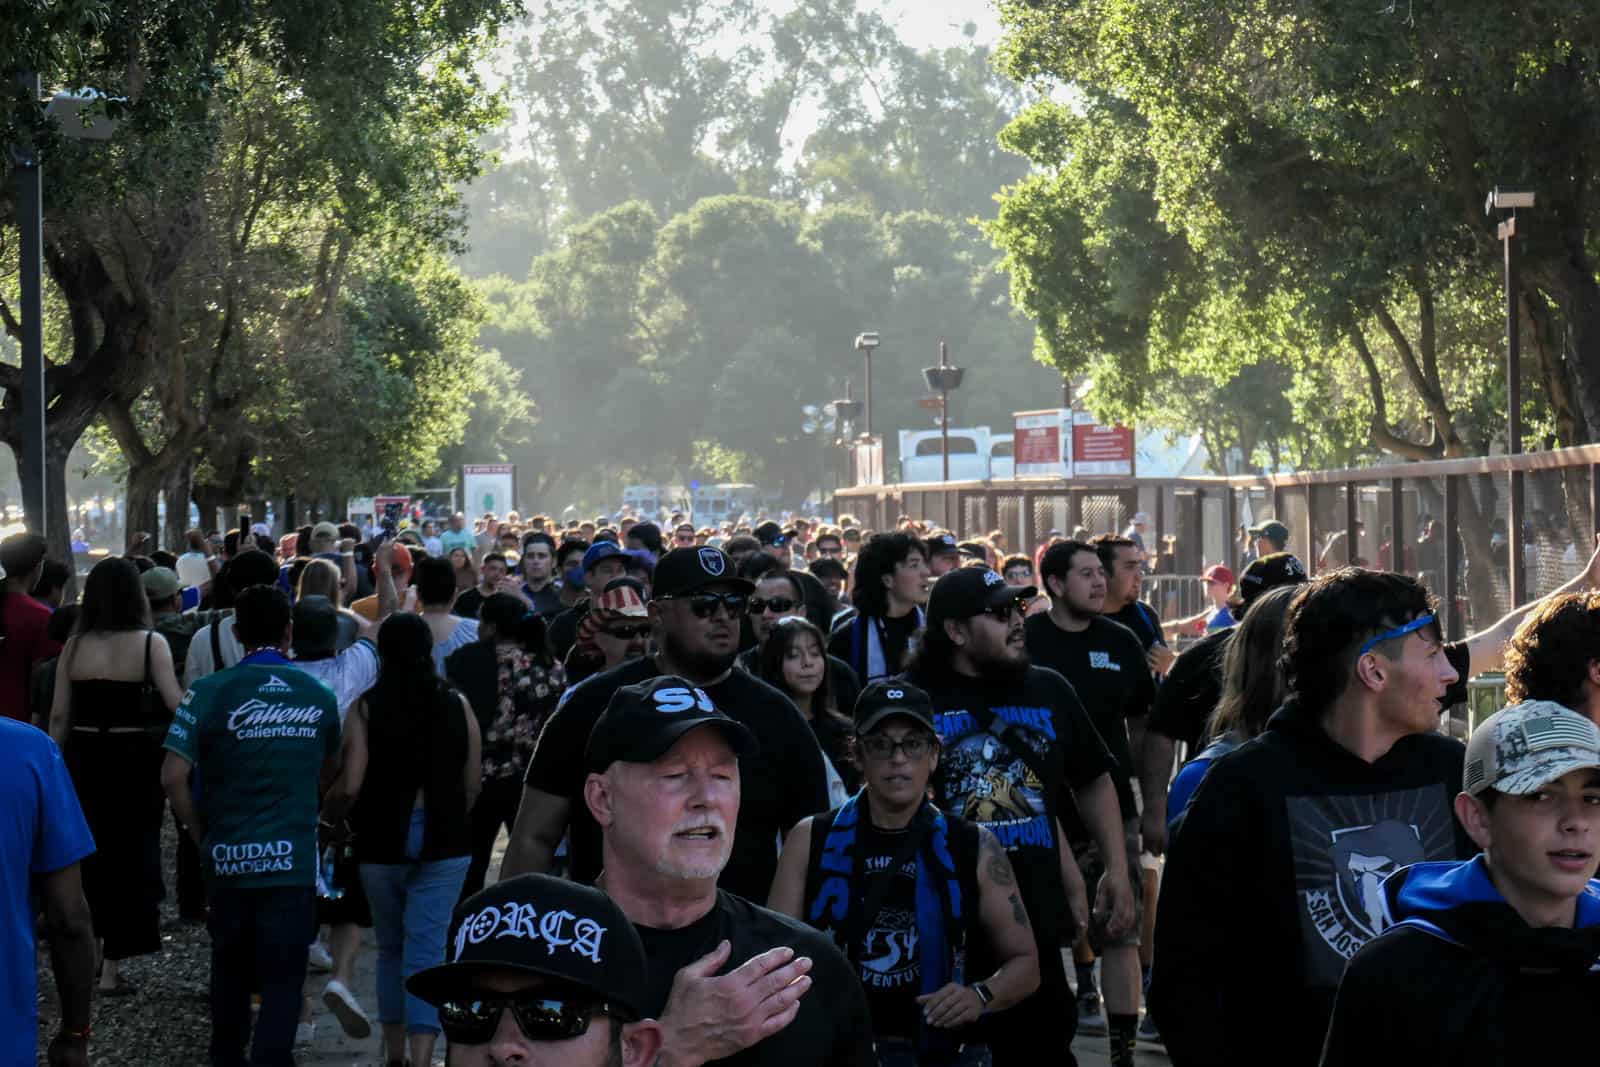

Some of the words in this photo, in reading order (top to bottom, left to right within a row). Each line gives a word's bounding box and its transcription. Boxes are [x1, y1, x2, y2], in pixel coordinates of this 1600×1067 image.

[227, 698, 324, 731] Caliente
[235, 725, 318, 741] caliente.mx
[212, 840, 293, 862] CIUDAD
[215, 856, 294, 877] MADERAS
[1309, 898, 1338, 933] SAN
[1329, 928, 1361, 957] JOS
